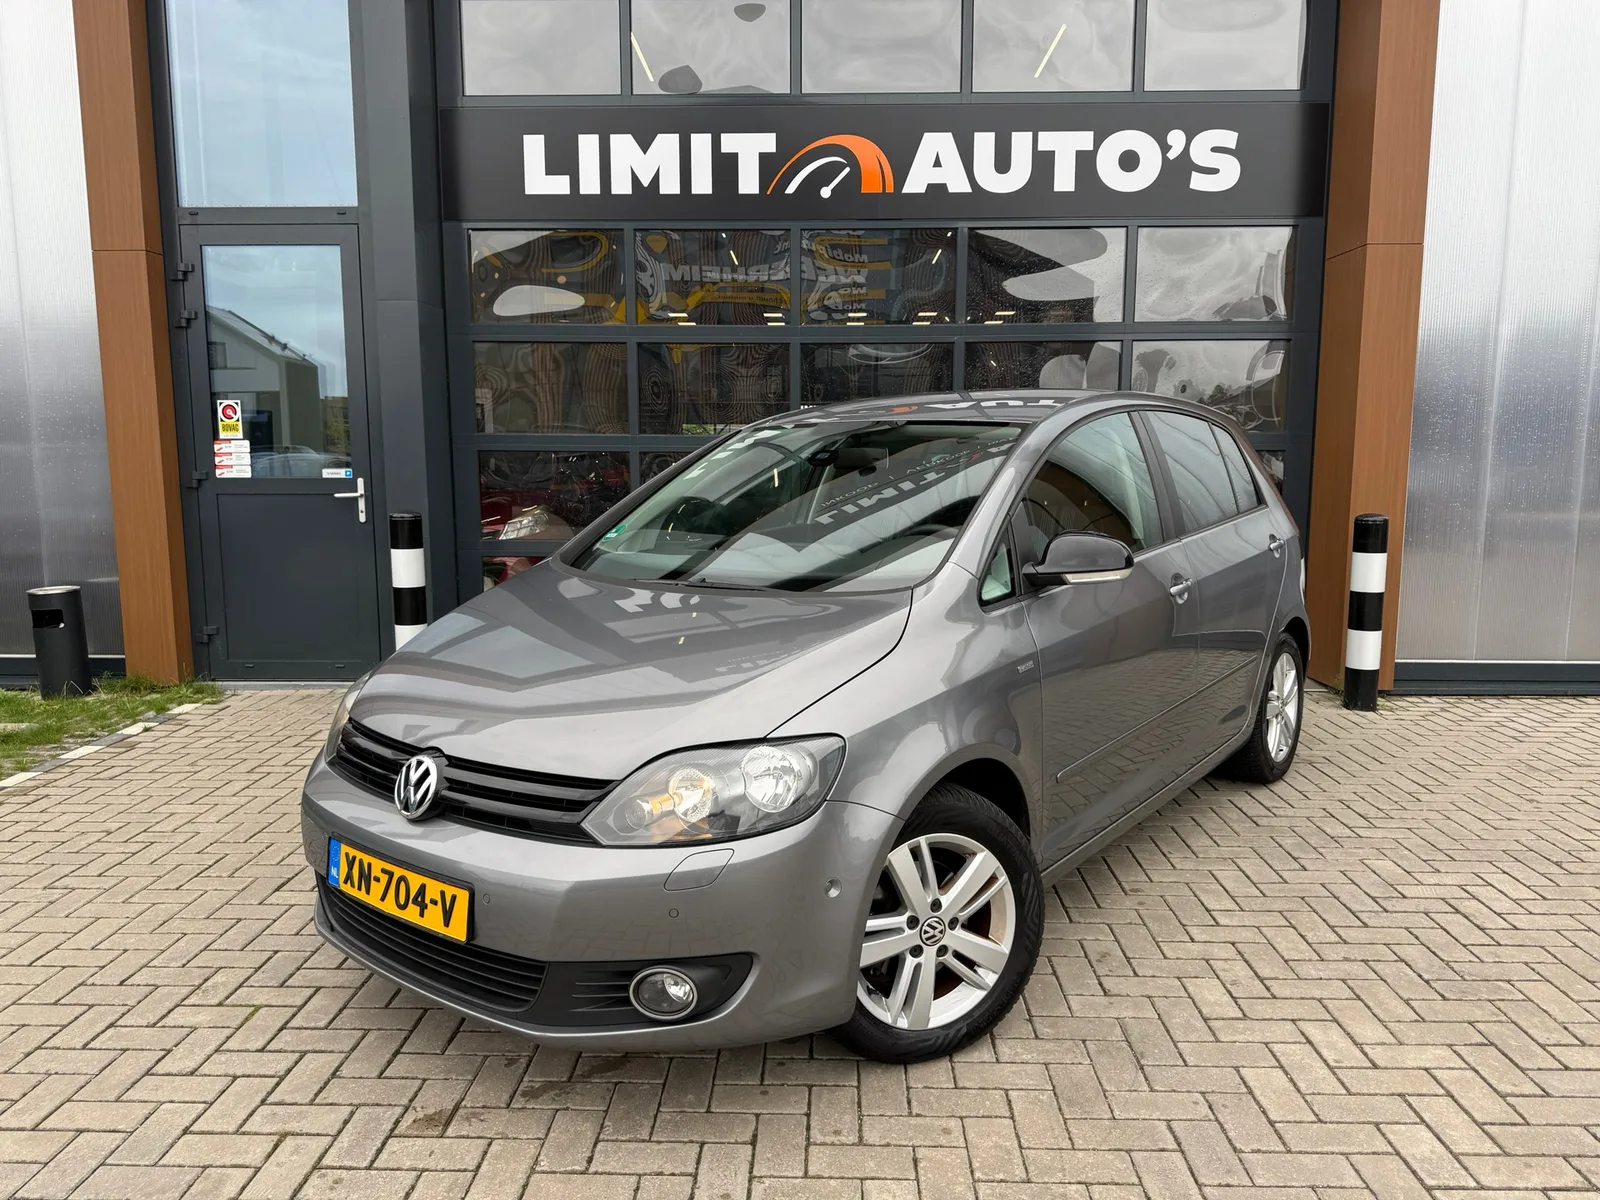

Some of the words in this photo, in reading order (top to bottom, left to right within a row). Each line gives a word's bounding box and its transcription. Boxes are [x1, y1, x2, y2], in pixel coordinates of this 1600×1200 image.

[523, 133, 777, 195] LIMIT
[901, 129, 1241, 194] AUTO'S
[331, 865, 338, 878] NL
[343, 851, 457, 928] XN-704-V
